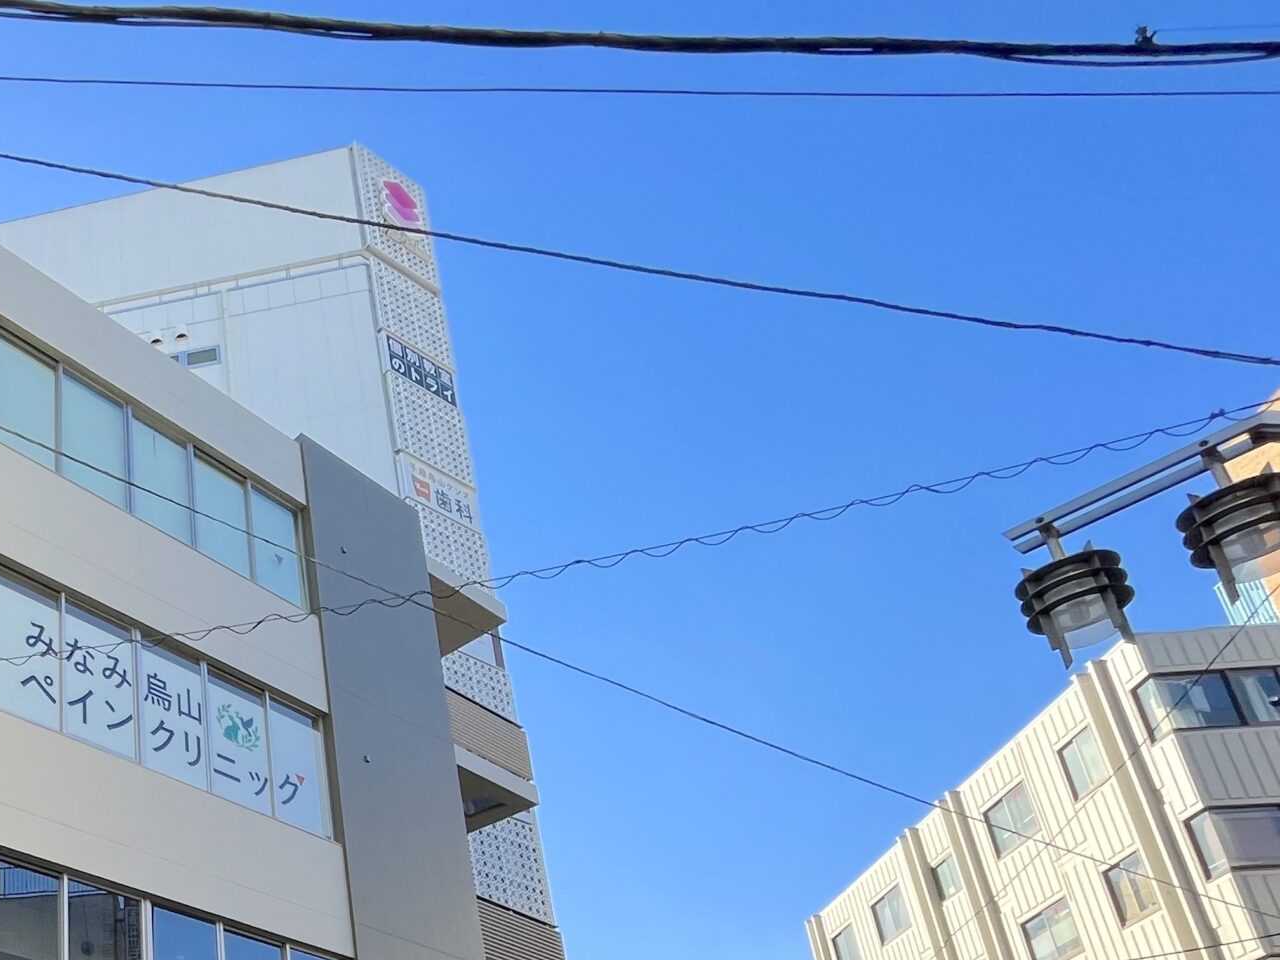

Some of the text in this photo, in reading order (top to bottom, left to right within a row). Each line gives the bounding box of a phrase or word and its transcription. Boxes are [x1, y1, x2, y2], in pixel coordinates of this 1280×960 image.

[391, 358, 454, 403] のトライ
[434, 488, 473, 524] 歯科
[25, 621, 202, 727] みなみ烏山
[21, 674, 301, 806] ペインクリニック
